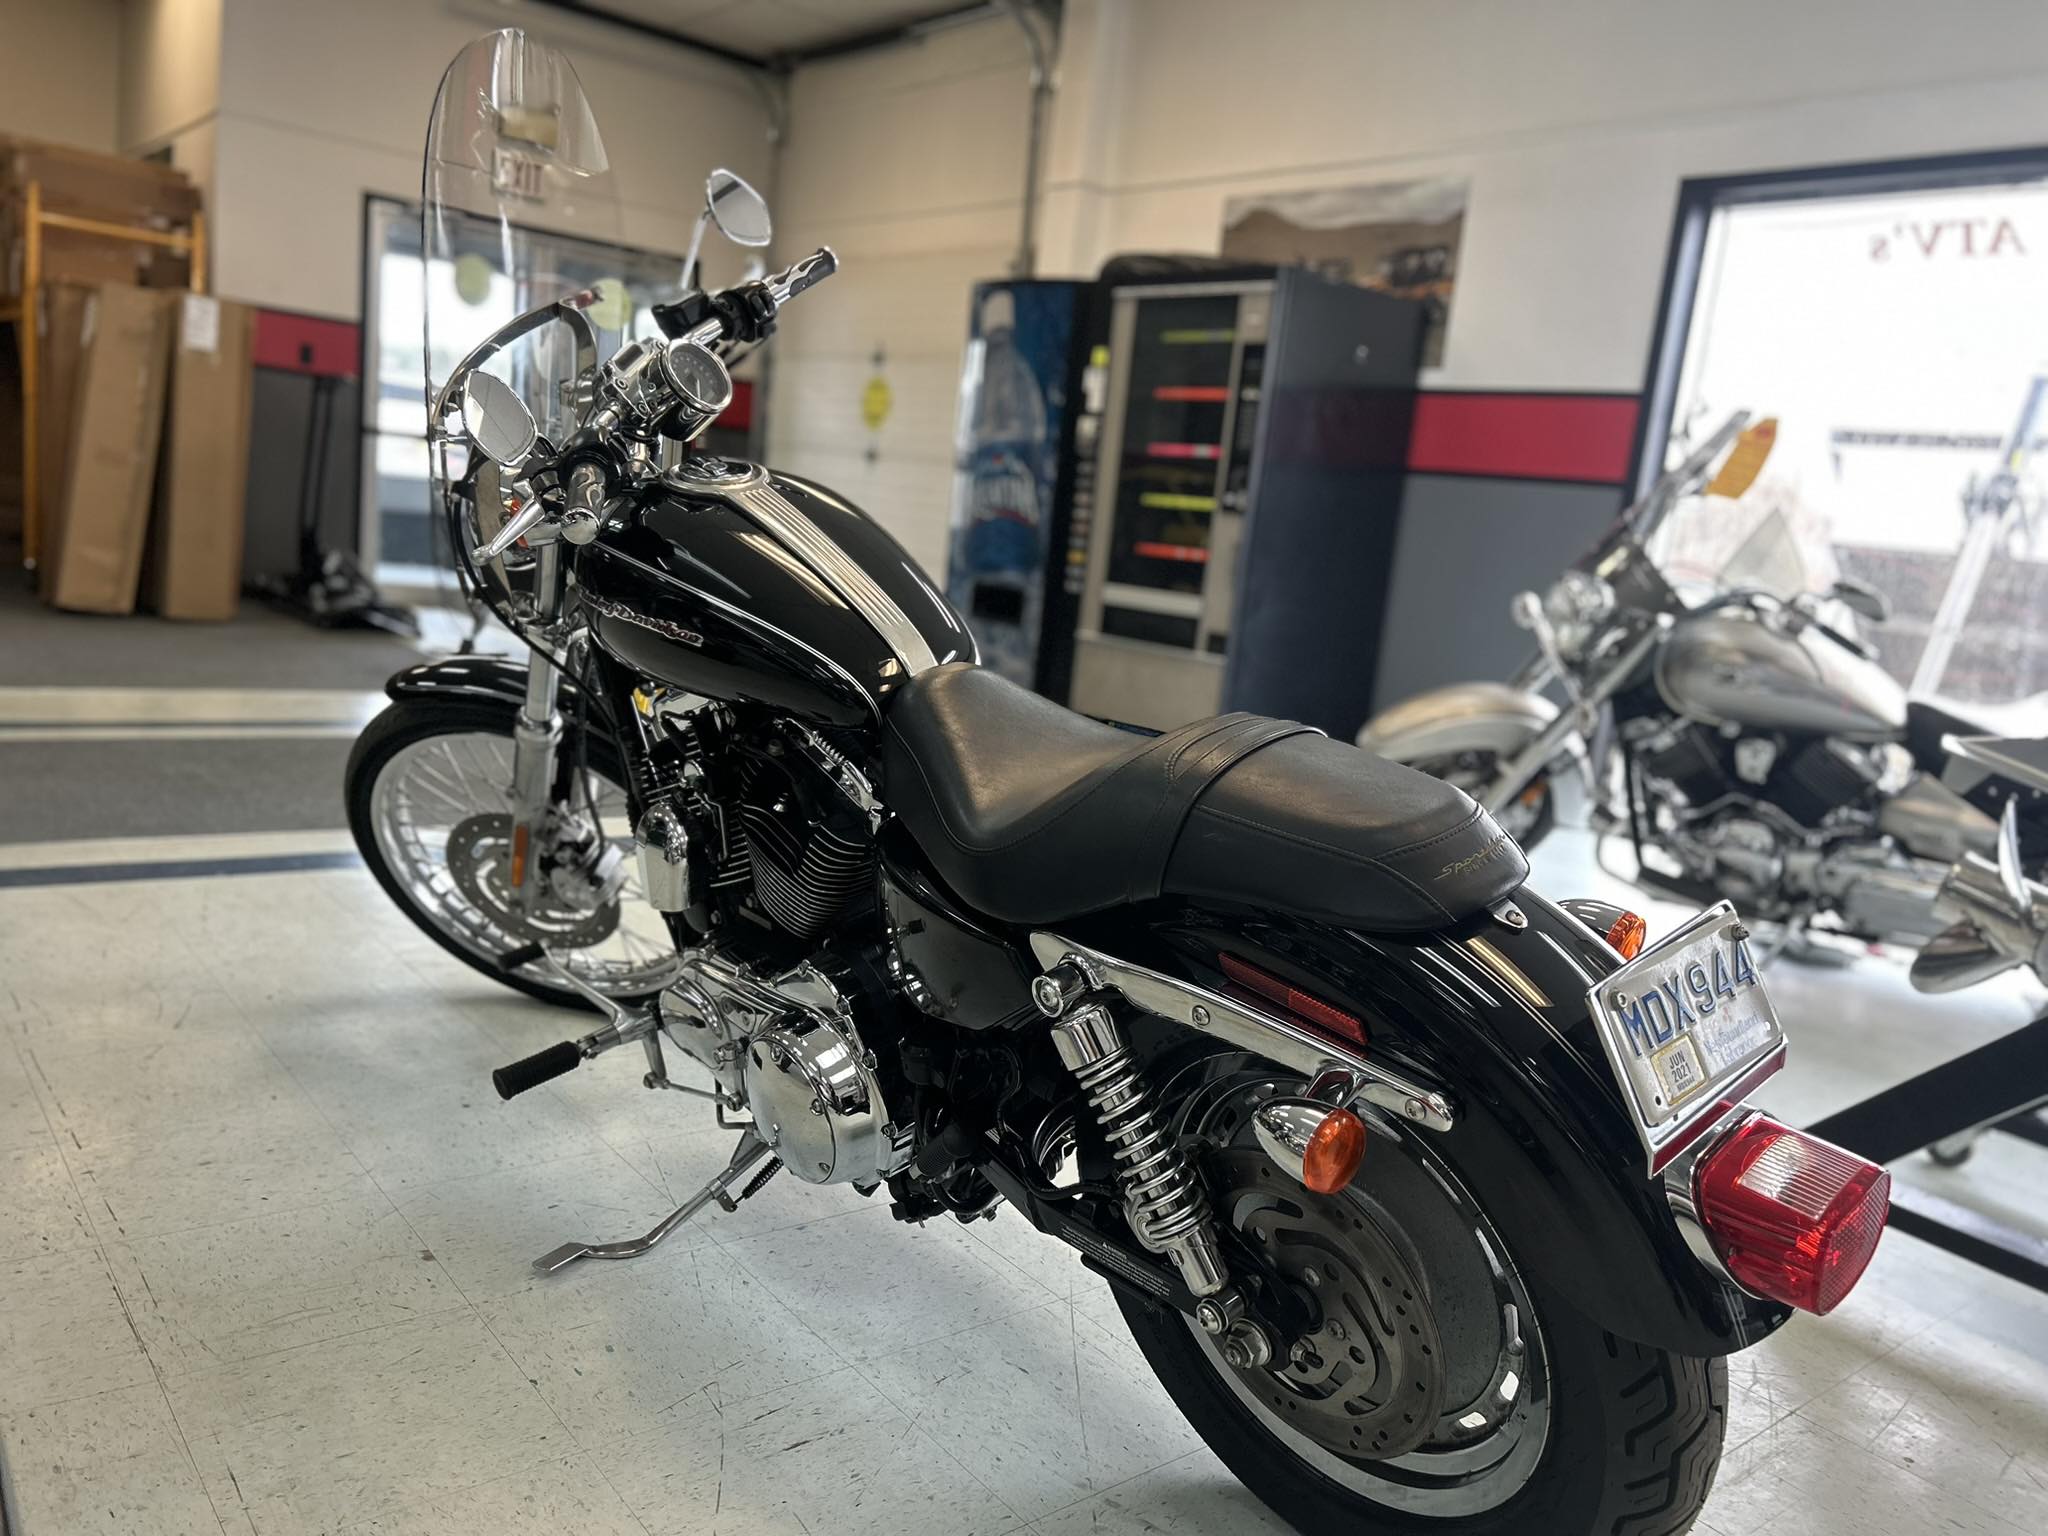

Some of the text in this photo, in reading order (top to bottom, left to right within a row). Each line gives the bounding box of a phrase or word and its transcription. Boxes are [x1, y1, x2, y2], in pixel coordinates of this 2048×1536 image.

[1618, 939, 1756, 1057] MDX944
[1669, 1050, 1686, 1069] JUN
[1672, 1063, 1692, 1083] 2021
